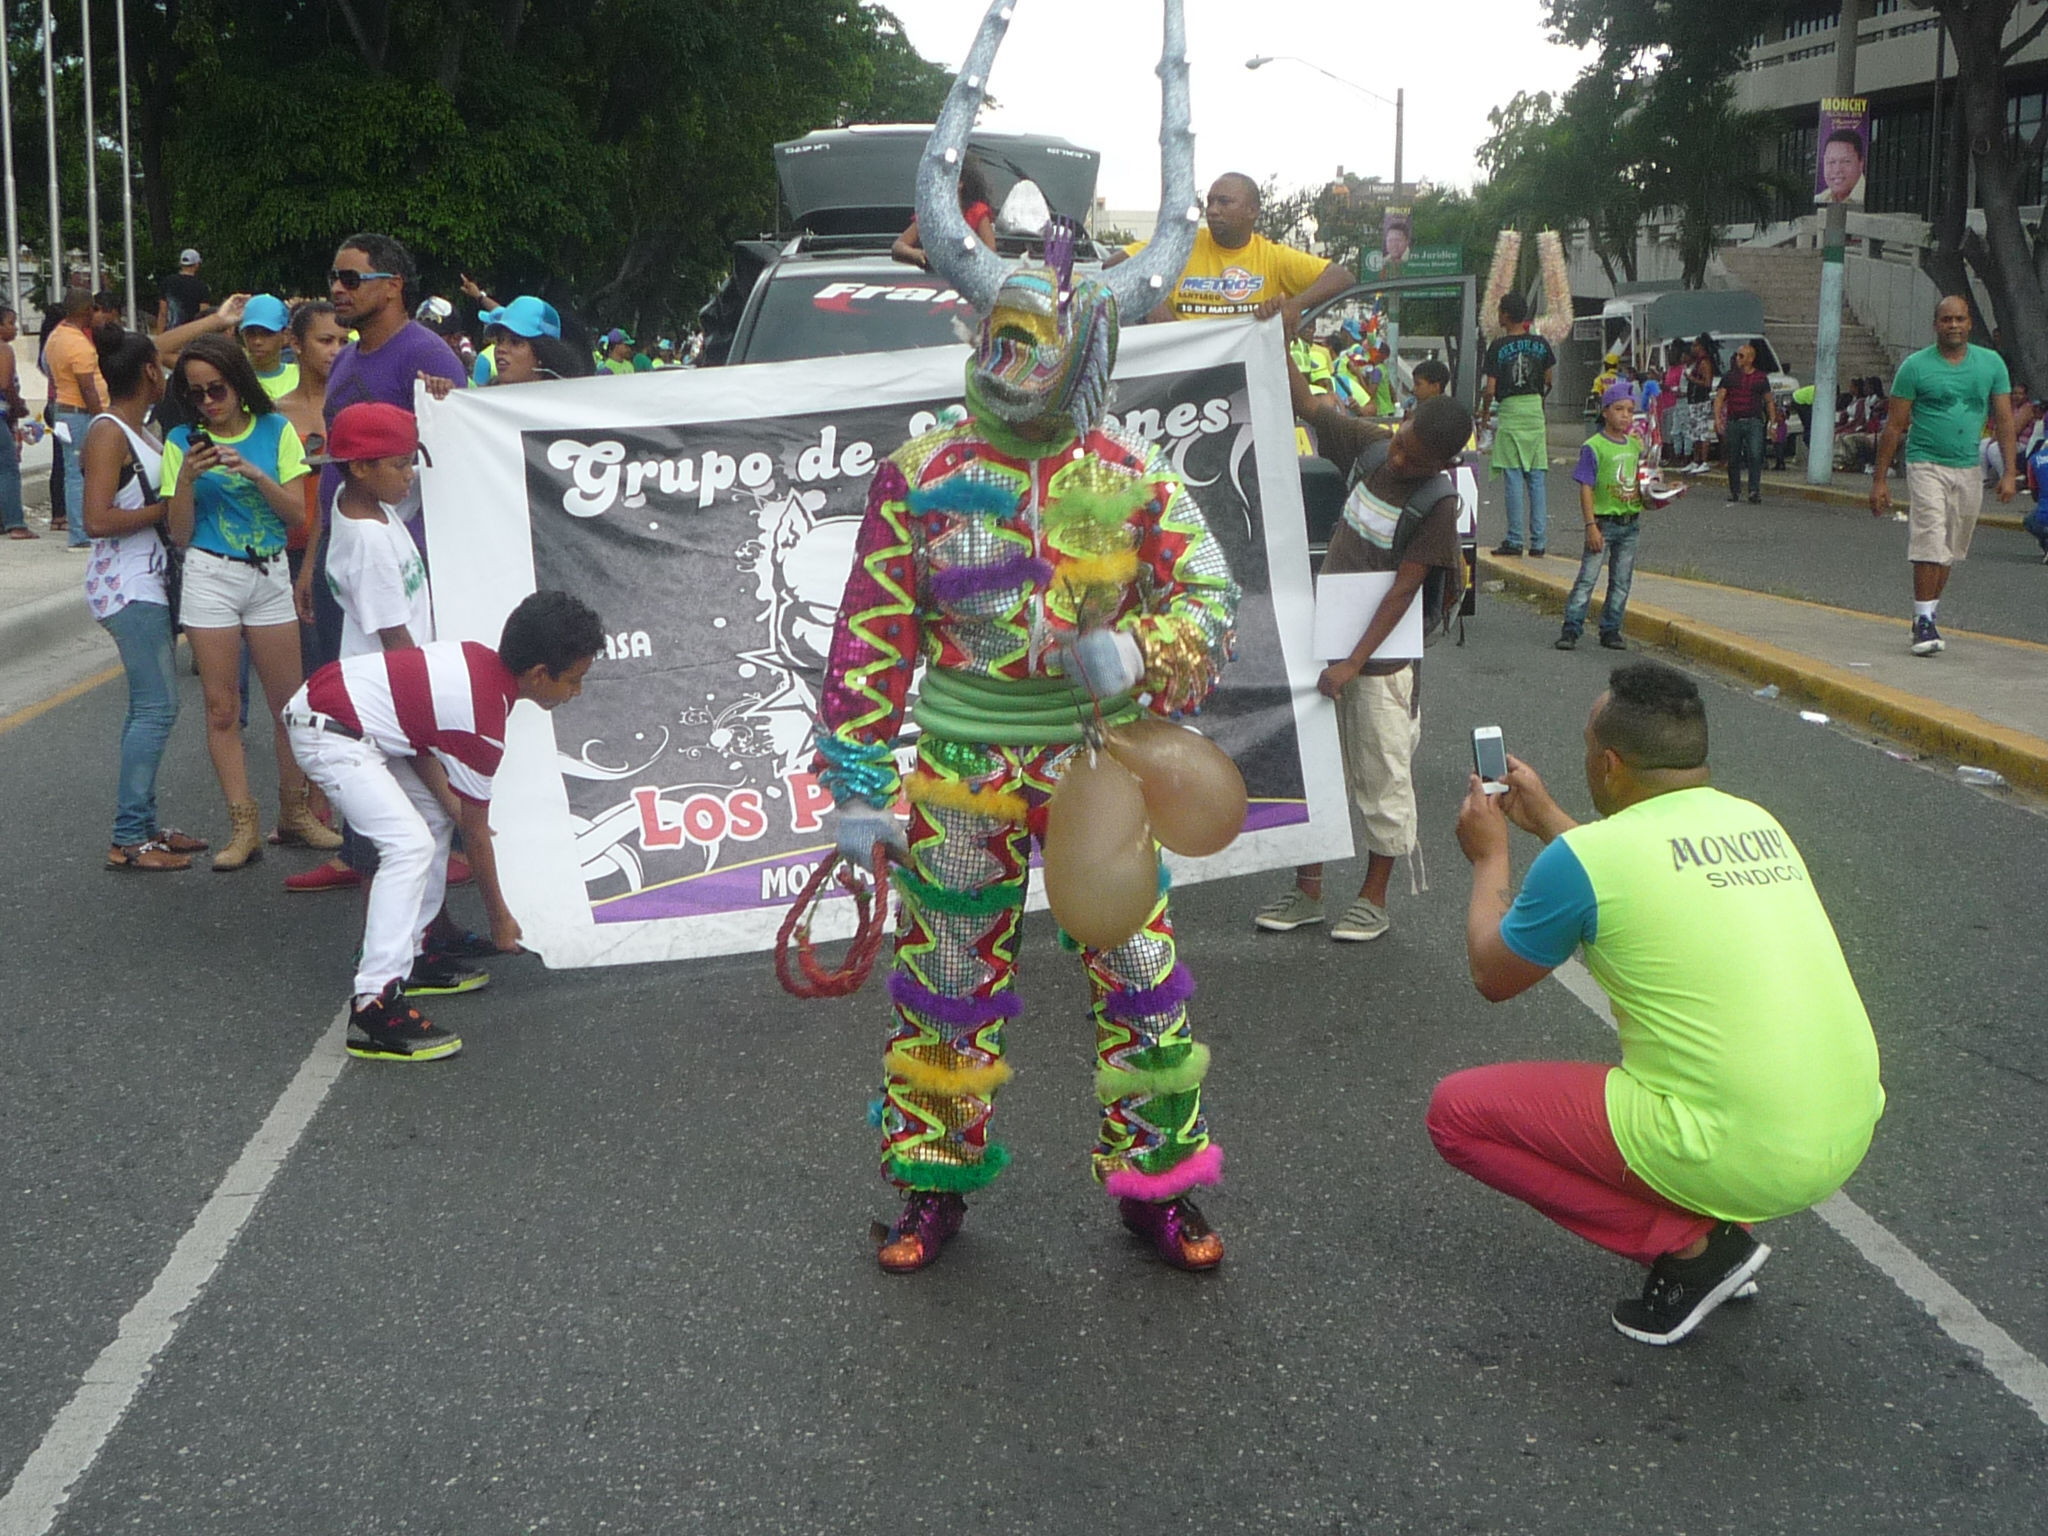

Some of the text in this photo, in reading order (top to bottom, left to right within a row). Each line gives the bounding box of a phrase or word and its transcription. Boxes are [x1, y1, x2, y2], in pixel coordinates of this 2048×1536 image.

[1821, 97, 1868, 112] MONCHY
[1180, 276, 1264, 293] METROS
[1195, 305, 1206, 313] DE
[1208, 305, 1235, 314] MAYO
[546, 425, 878, 518] Grupo de
[1667, 829, 1788, 872] MONCHY
[1705, 865, 1804, 888] SINDICO
